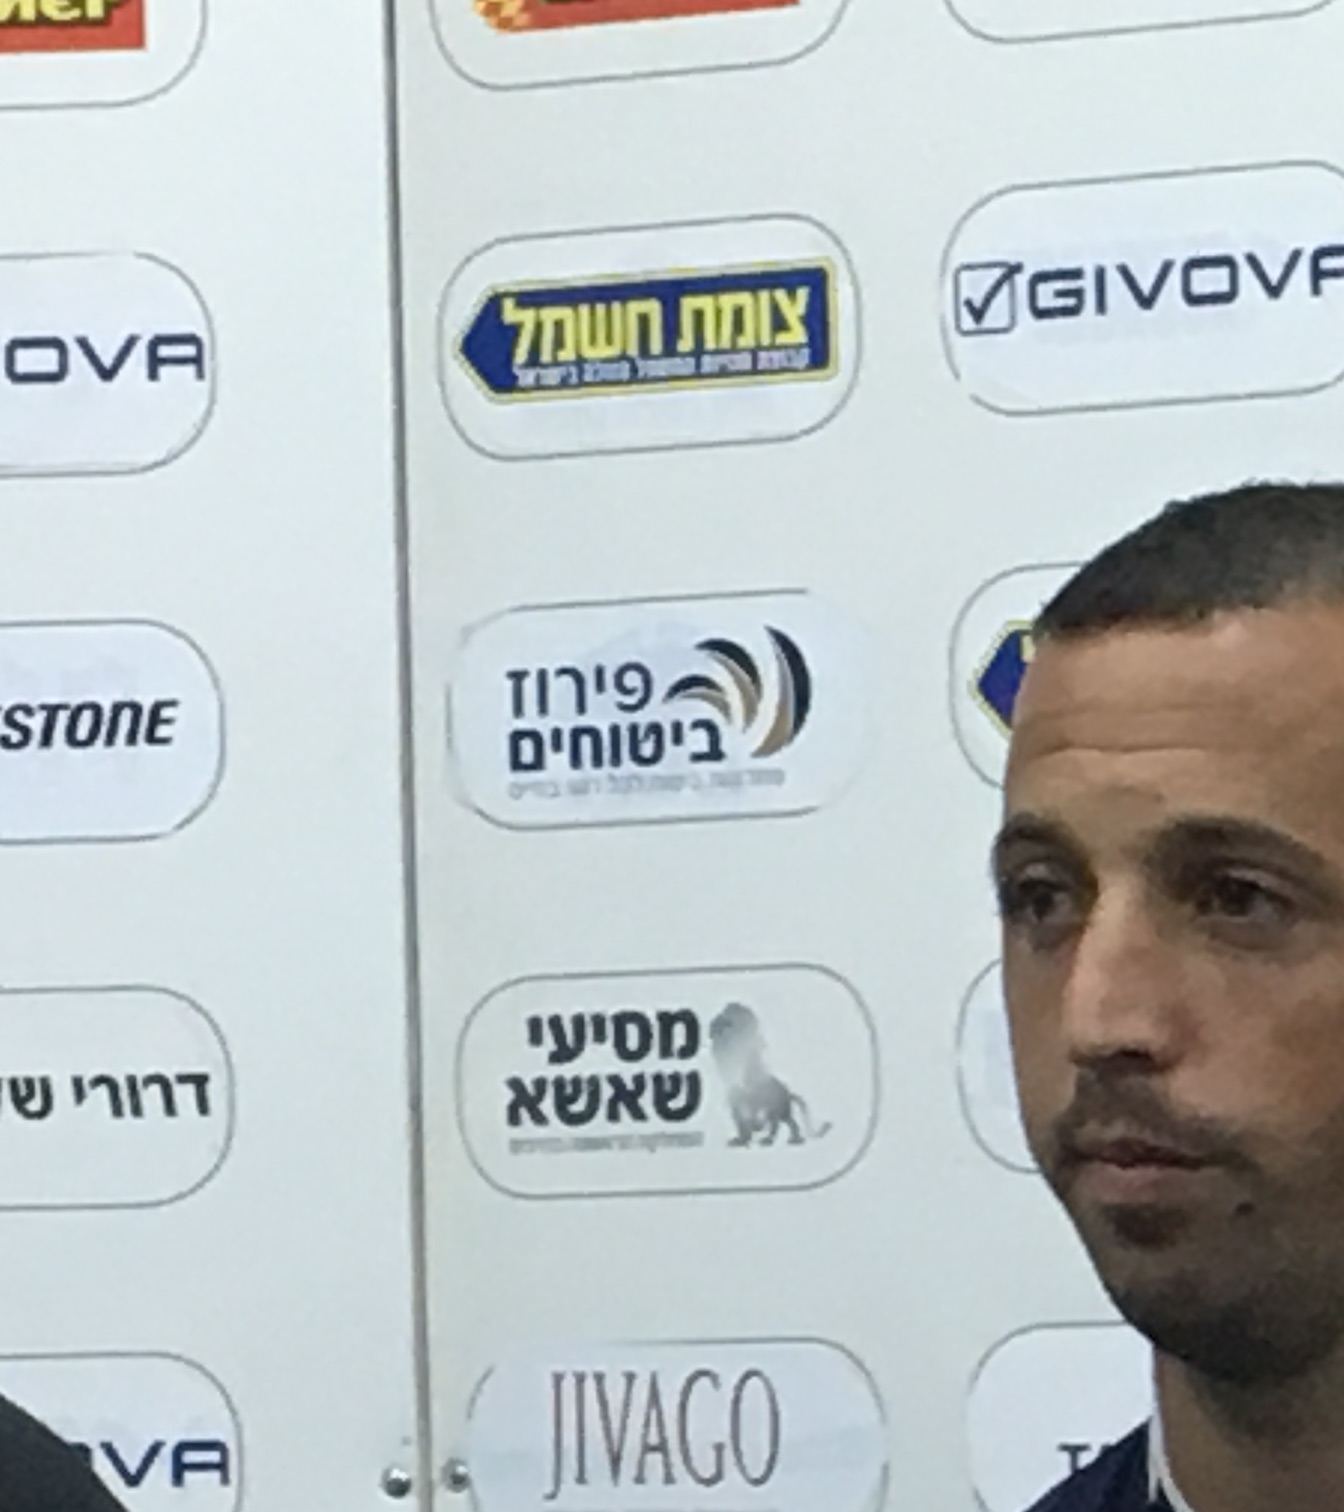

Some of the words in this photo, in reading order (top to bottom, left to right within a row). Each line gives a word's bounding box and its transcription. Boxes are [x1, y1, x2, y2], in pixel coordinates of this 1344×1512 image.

[502, 296, 663, 364] חשמל
[677, 286, 810, 350] צומת
[5, 333, 205, 384] OVA
[505, 662, 654, 718] פירוז
[509, 718, 726, 772] ביטוחים
[527, 1009, 699, 1065] מסיעי
[71, 1072, 210, 1119] דרורי
[505, 1069, 701, 1127] שאשא
[542, 1368, 781, 1501] JIVAGO
